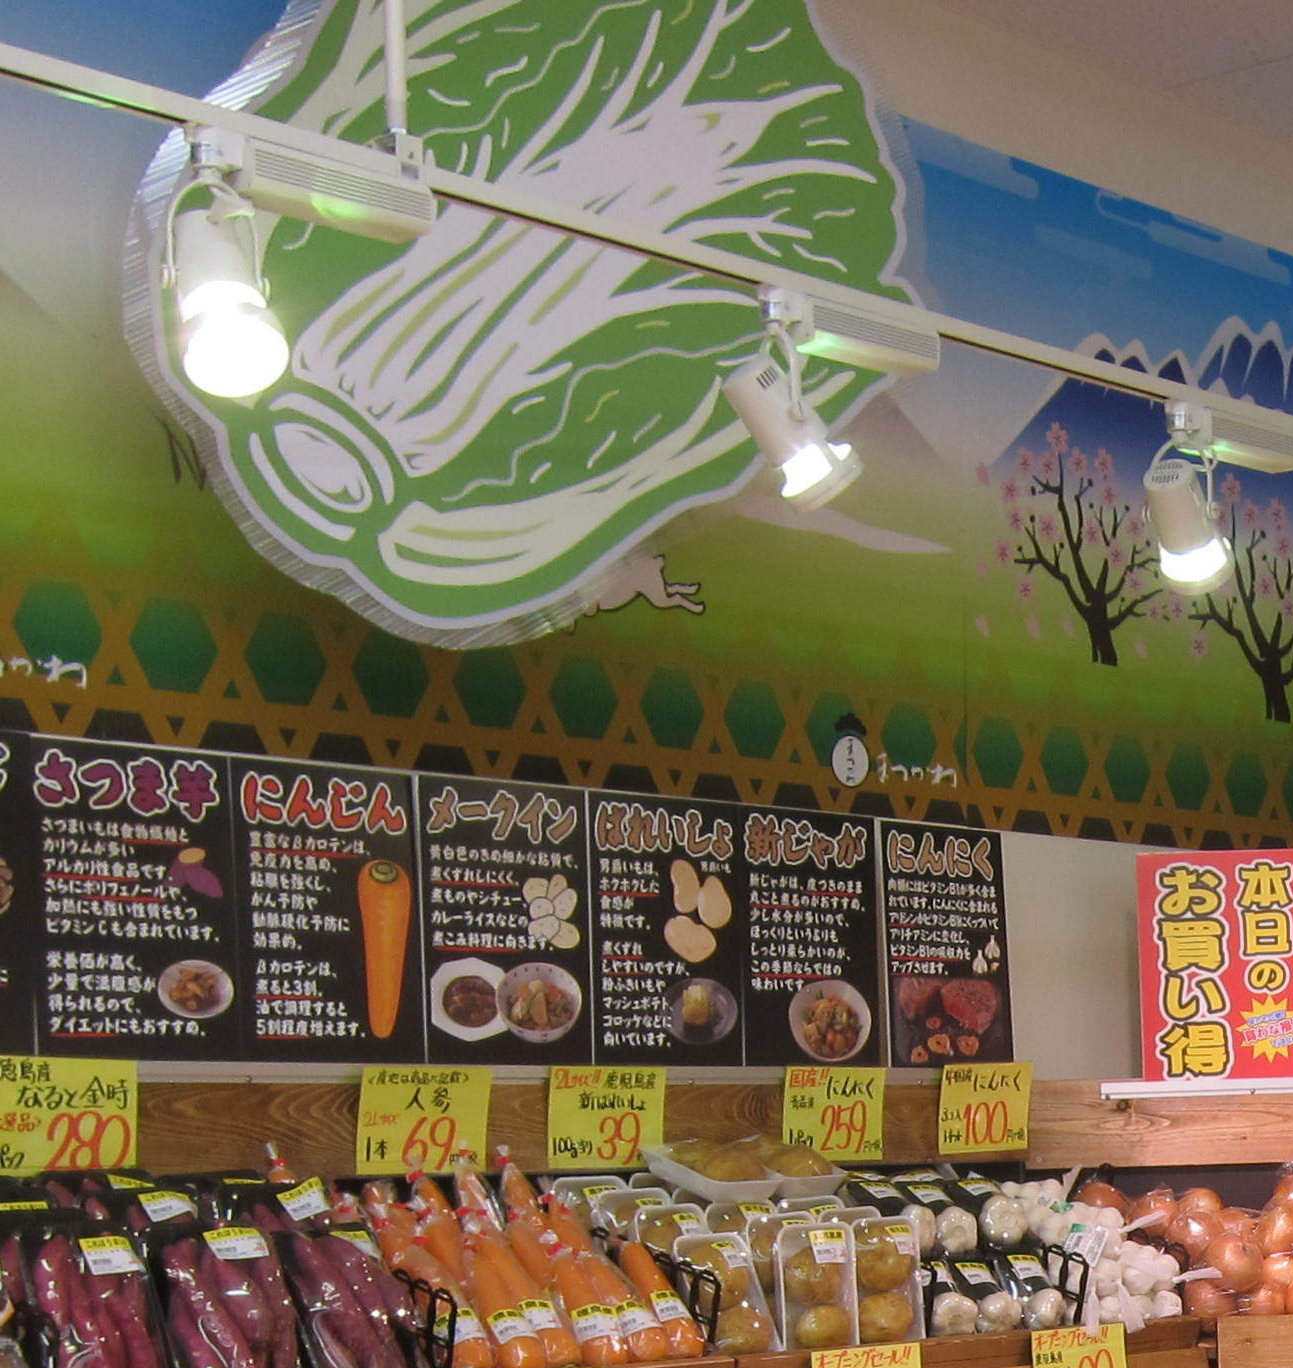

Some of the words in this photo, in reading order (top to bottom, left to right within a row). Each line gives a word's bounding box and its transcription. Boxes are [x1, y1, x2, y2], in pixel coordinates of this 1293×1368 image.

[34, 748, 219, 822] さつま芋
[241, 772, 406, 835] にんじん
[427, 786, 577, 844] メークイン
[595, 801, 733, 860] ばれいしょ
[744, 812, 867, 869] 新じゃが
[43, 839, 135, 857] カリウムが多い
[887, 829, 994, 881] にんにく
[599, 877, 660, 894] ホクホクした
[252, 894, 317, 910] がん予防や
[601, 897, 634, 910] 食感が
[431, 911, 528, 927] カレーライスなどの
[750, 926, 838, 942] ほっくりというよりも
[601, 941, 643, 957] 煮くずれ
[48, 973, 156, 992] 少量で満腹感が
[1153, 858, 1234, 1081] お買い得
[256, 999, 348, 1016] 油で調理すると
[603, 1014, 672, 1029] コロッケなどに
[17, 1076, 128, 1110] なると金時
[827, 1076, 875, 1099] にんにく
[973, 1069, 1021, 1092] にんにく
[821, 1101, 867, 1153] 259
[963, 1101, 1008, 1145] 100
[44, 1110, 130, 1171] 280
[366, 1136, 388, 1162] 1本
[402, 1116, 456, 1171] 69
[596, 1112, 641, 1165] 39
